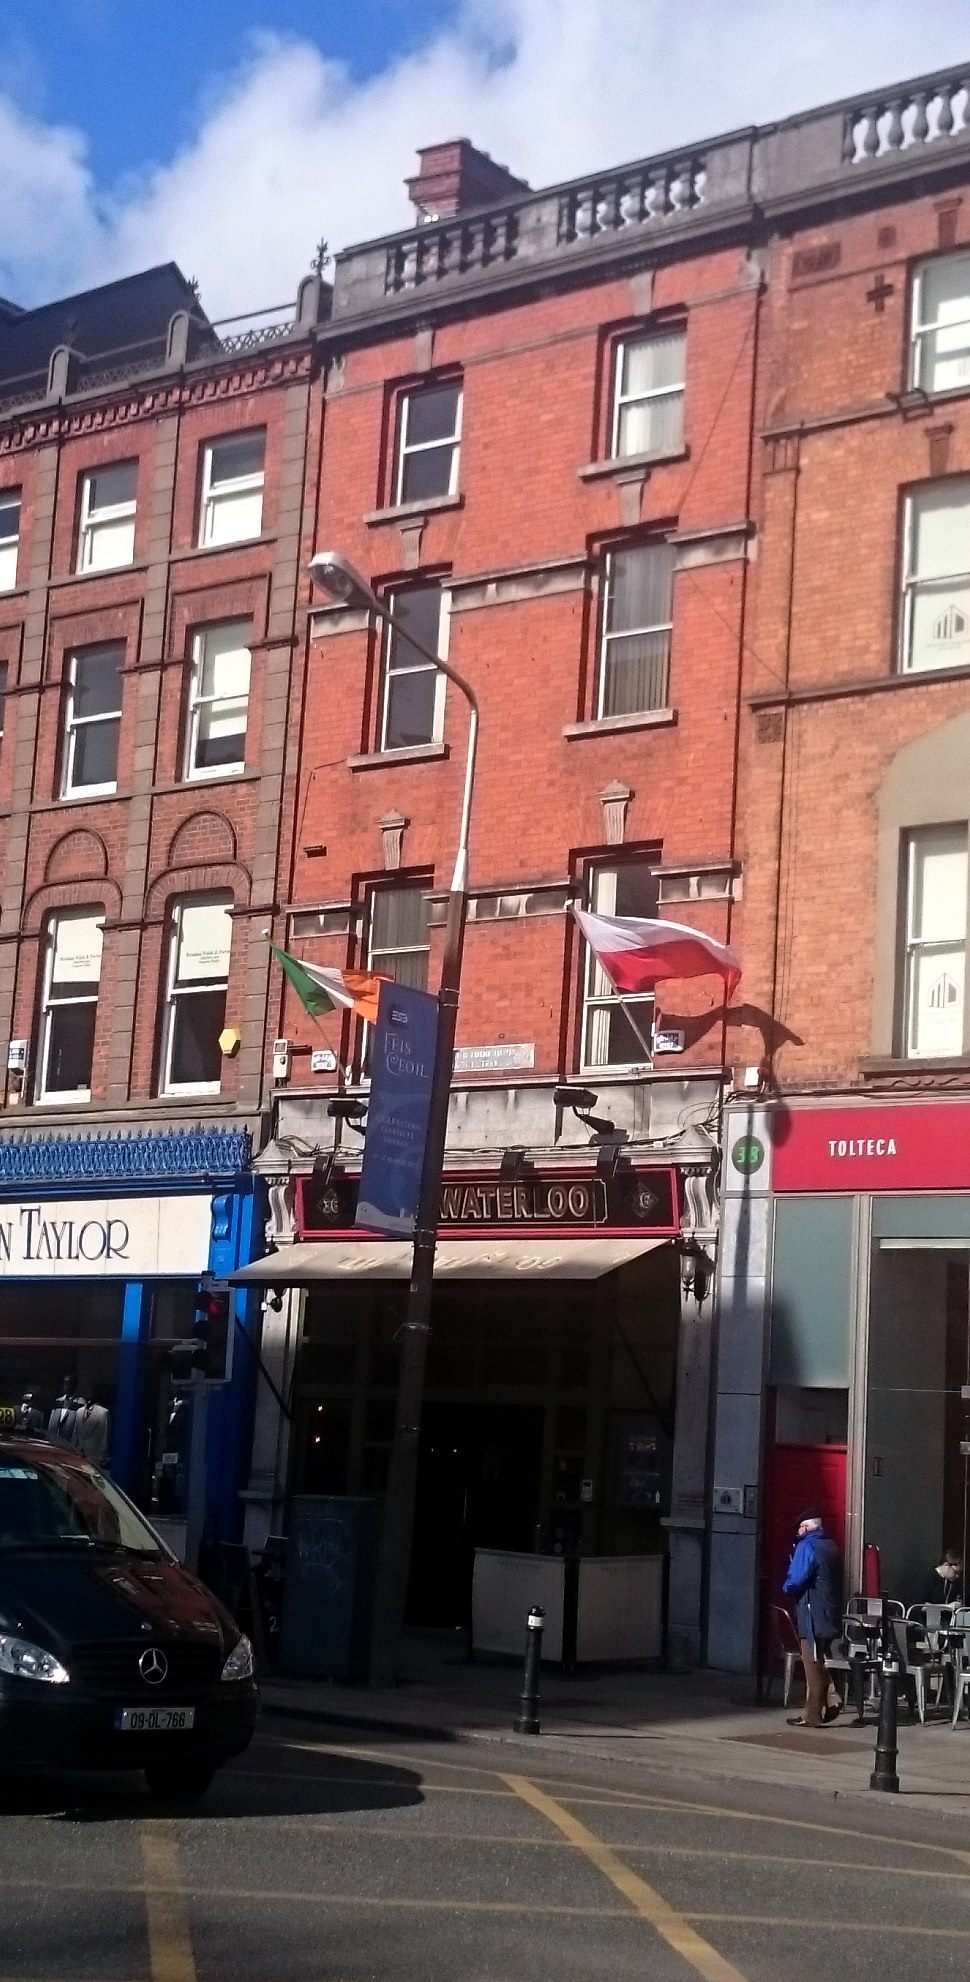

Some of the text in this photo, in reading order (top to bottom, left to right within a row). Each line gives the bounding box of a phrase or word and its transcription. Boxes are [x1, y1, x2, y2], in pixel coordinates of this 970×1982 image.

[737, 1146, 760, 1164] 38
[828, 1138, 897, 1157] TOLTECA
[440, 1185, 589, 1219] WATERLOO
[19, 1205, 130, 1261] TAYLOR
[130, 1711, 187, 1729] 09-DL-766
